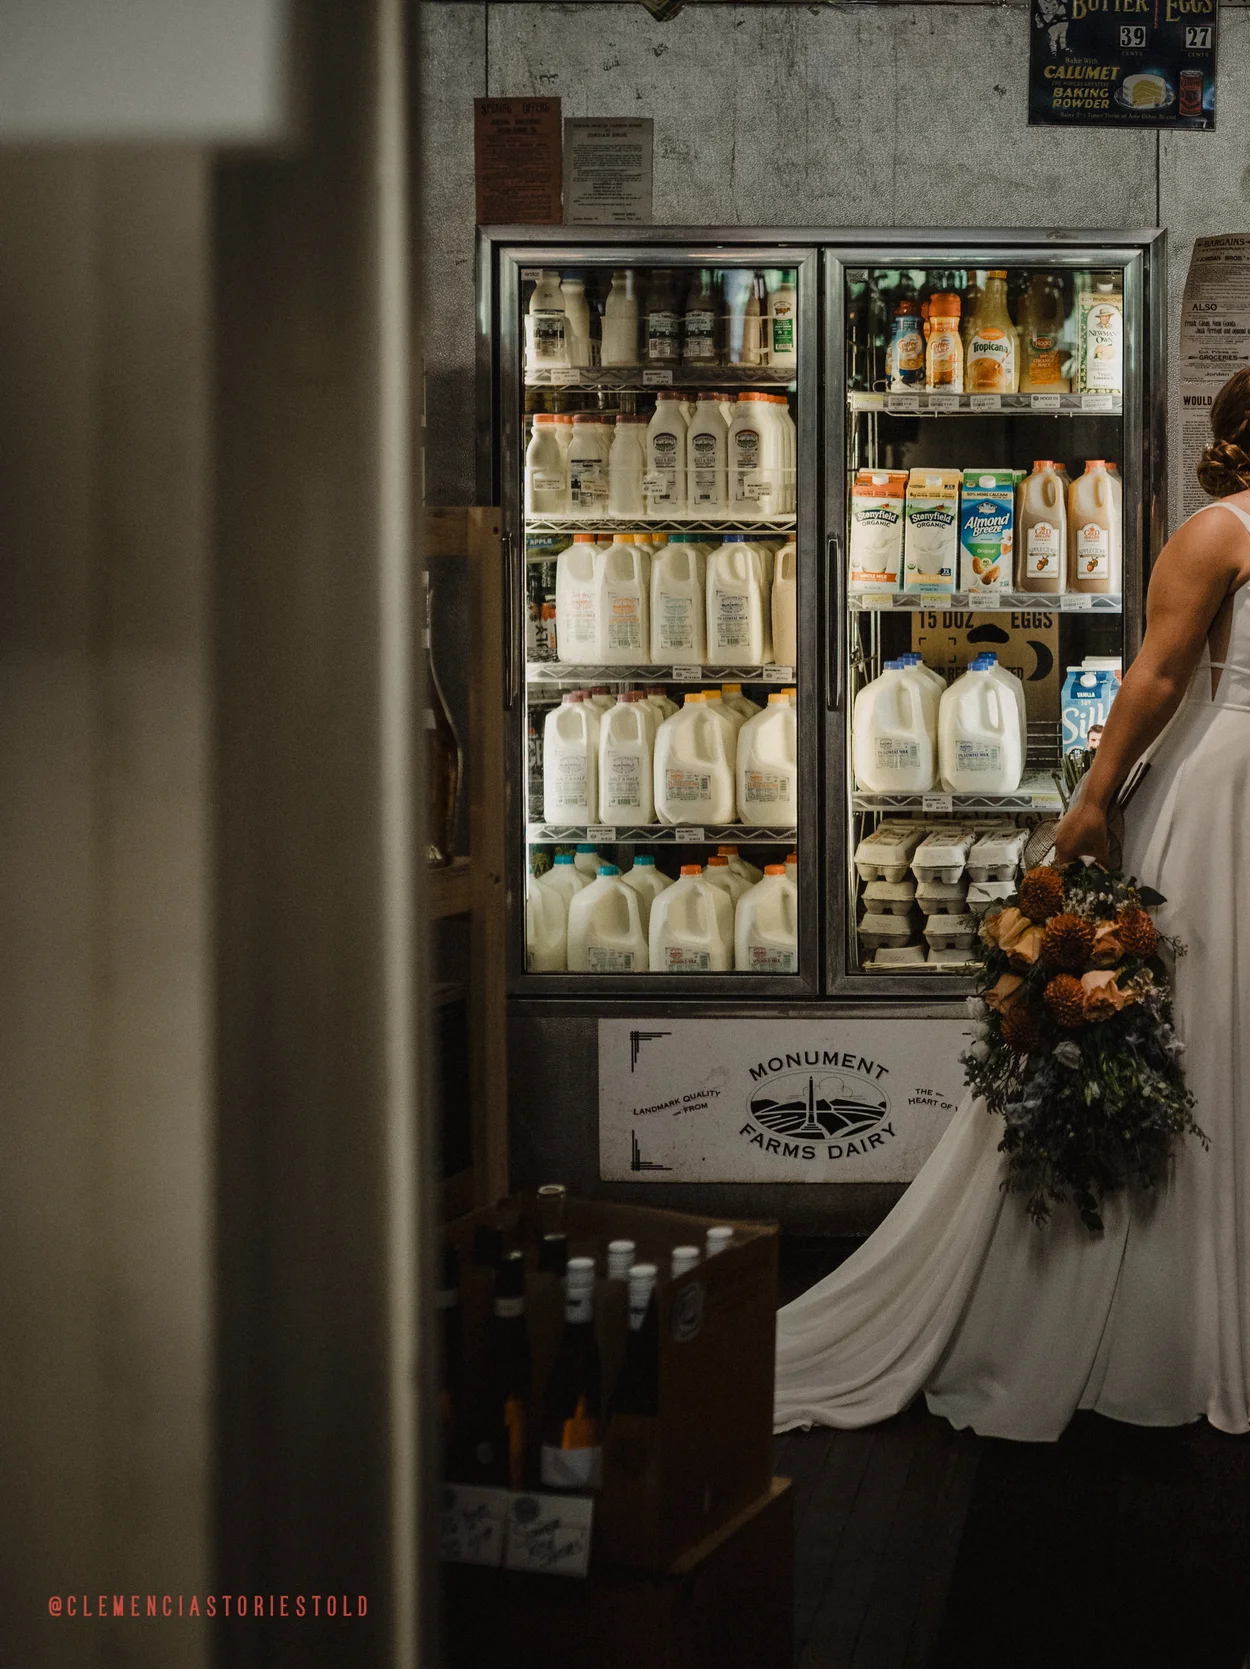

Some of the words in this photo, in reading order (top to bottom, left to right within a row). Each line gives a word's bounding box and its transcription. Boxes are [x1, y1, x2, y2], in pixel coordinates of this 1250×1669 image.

[1121, 27, 1145, 46] 39
[1187, 27, 1209, 47] 27
[1065, 57, 1083, 65] Bake
[1083, 57, 1098, 65] With
[1043, 64, 1120, 81] CALUMET
[1052, 88, 1109, 98] BAKING
[1052, 98, 1110, 109] POWDER
[1203, 238, 1245, 248] BARGAINS
[1192, 303, 1218, 311] ALSO
[972, 341, 1009, 353] Tropicana
[1183, 395, 1213, 406] WOULD
[857, 510, 897, 521] Stonyfield
[911, 510, 952, 525] Stonyfield
[964, 513, 1010, 530] Almond
[862, 520, 891, 528] ORGANIC
[917, 521, 946, 529] ORGANIC
[972, 525, 1003, 538] Breeze
[918, 611, 937, 629] 15
[942, 611, 975, 629] DOZ
[1011, 611, 1053, 629] EGGS
[748, 1051, 890, 1081] MONUMENT
[915, 1088, 934, 1096] THE
[633, 1098, 681, 1116] LANDMARK
[682, 1090, 721, 1102] QUALITY
[683, 1103, 709, 1114] FROM
[908, 1097, 939, 1106] HEART
[940, 1102, 953, 1110] OF
[739, 1123, 817, 1160] FARMS
[828, 1122, 897, 1160] DAIRY
